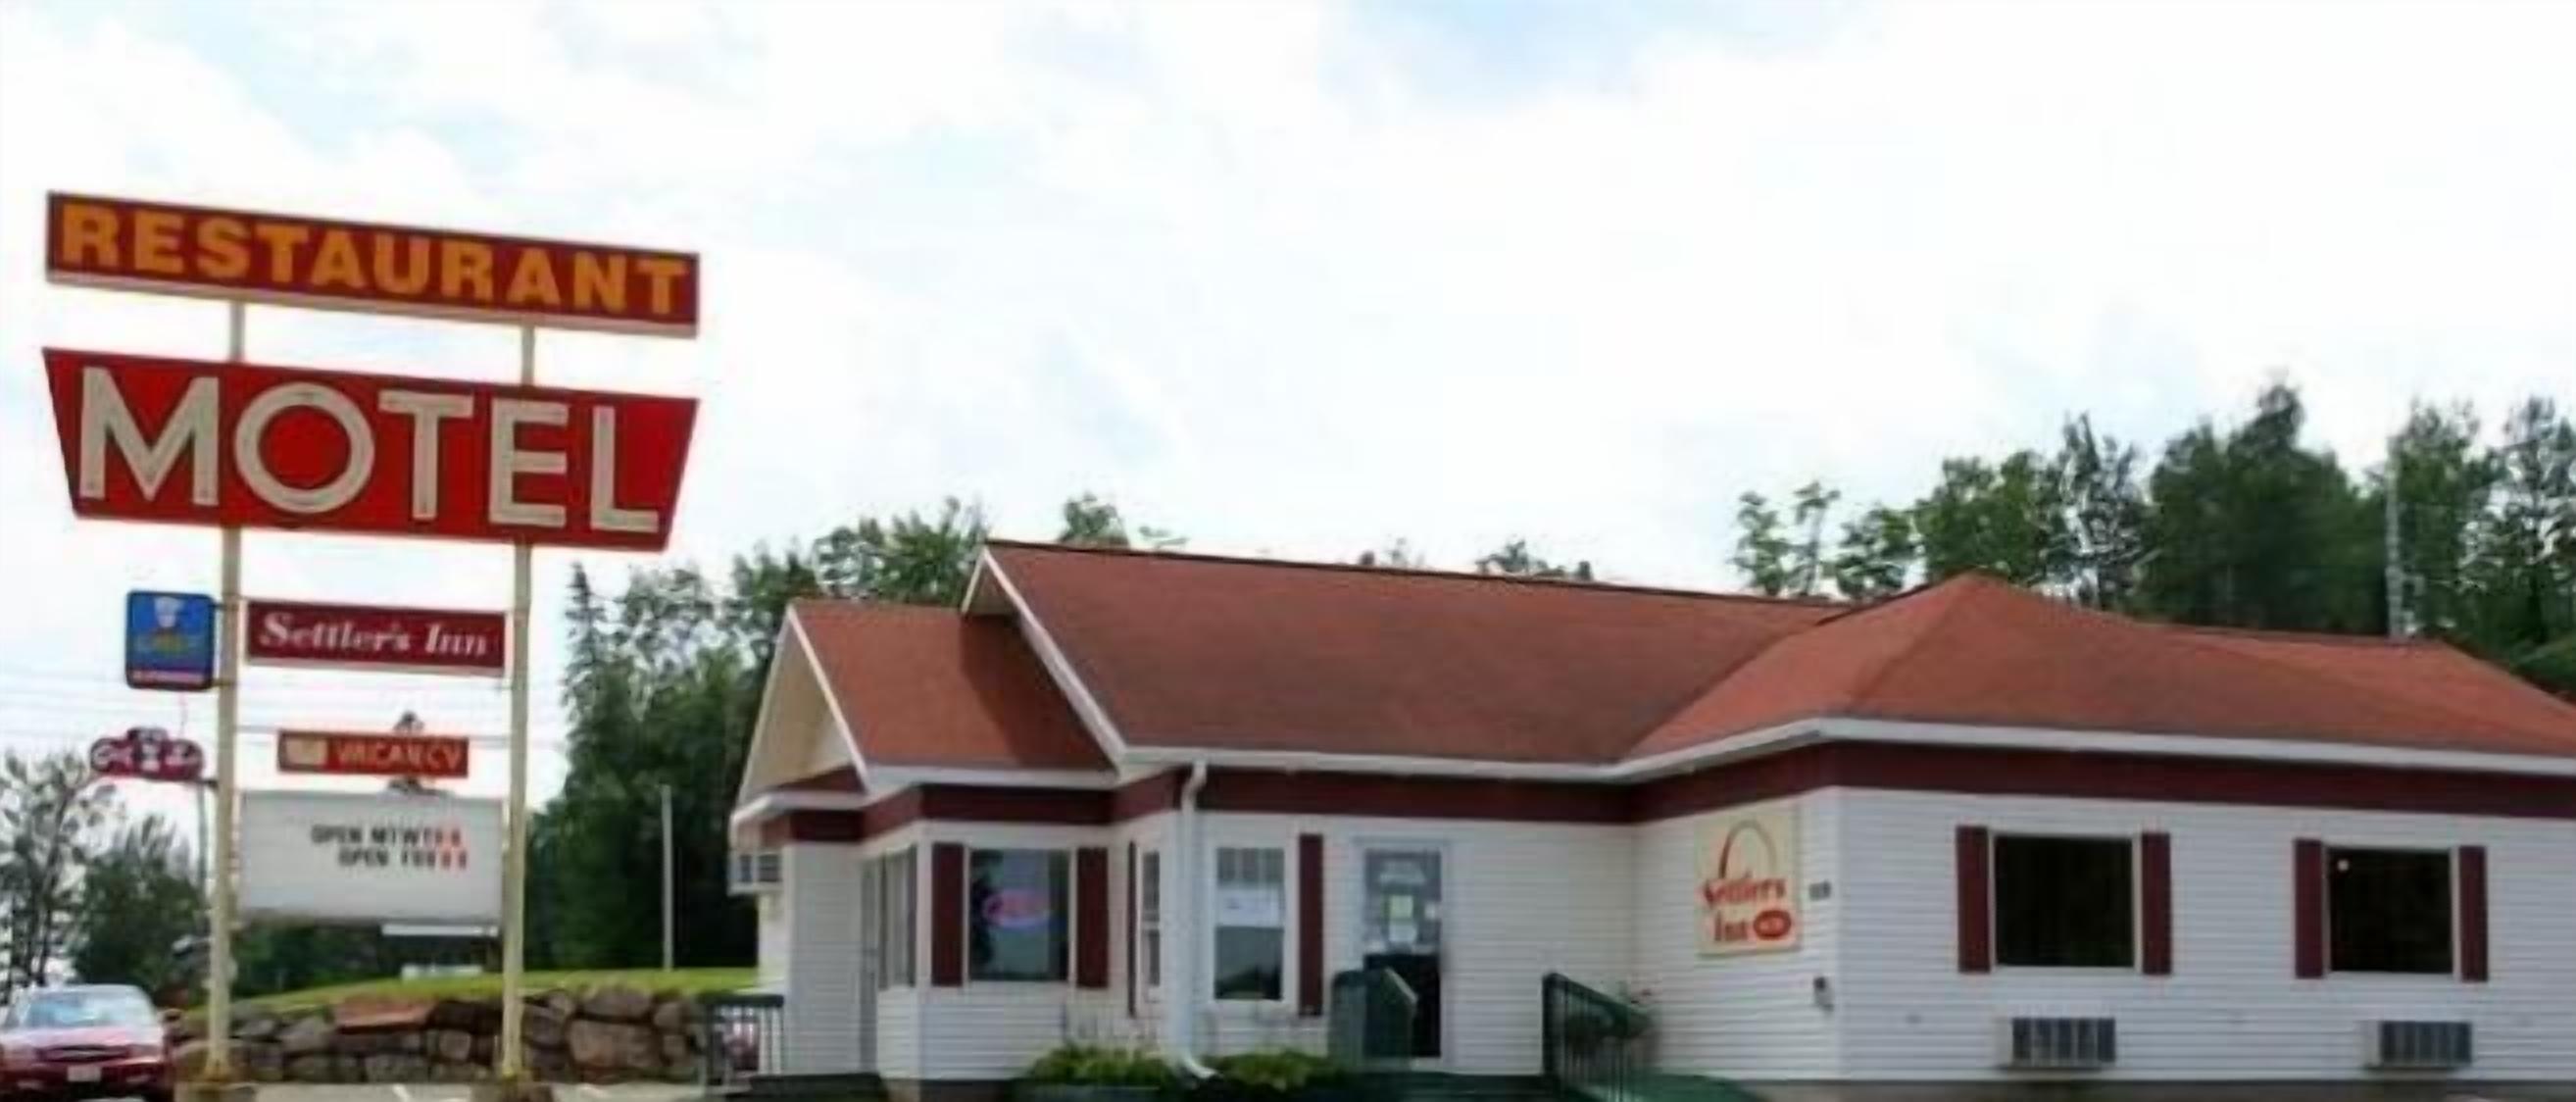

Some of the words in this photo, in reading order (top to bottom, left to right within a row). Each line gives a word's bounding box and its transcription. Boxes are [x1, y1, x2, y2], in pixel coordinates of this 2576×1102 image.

[60, 201, 690, 316] RESTAURANT
[77, 365, 663, 534] MOTEL
[258, 610, 411, 652] Settler's
[423, 624, 488, 656] Inn
[338, 740, 466, 771] VACANCY
[310, 824, 363, 845] OPEN
